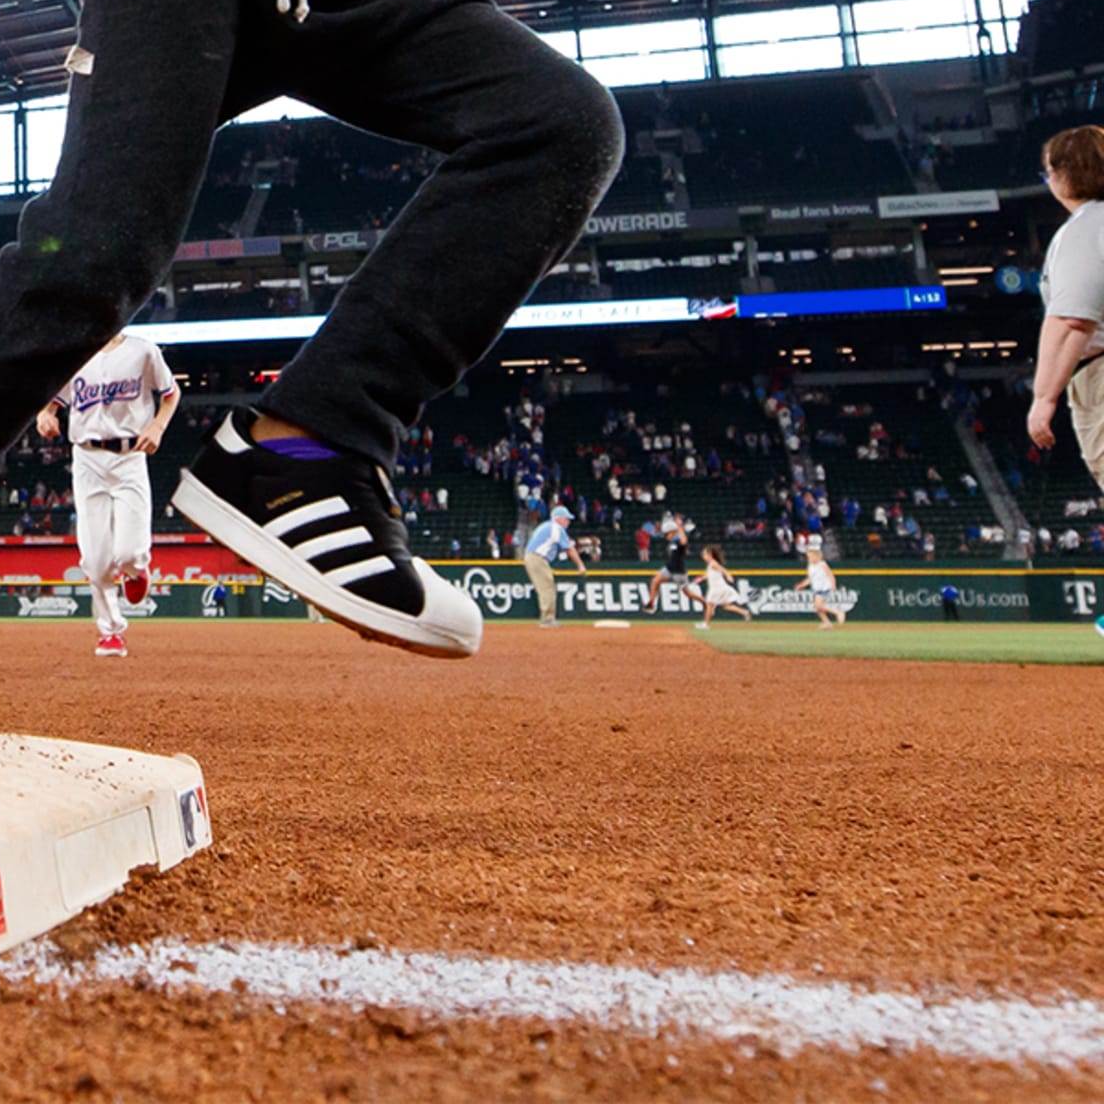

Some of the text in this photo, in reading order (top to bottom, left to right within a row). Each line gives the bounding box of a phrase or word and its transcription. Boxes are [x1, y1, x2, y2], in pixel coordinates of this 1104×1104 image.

[771, 201, 874, 219] Real fans know.
[585, 212, 689, 234] OWERADE
[531, 308, 584, 321] HOME
[72, 377, 143, 407] Rangers
[887, 588, 1030, 607] HeGeUs.com
[1063, 580, 1097, 615] T
